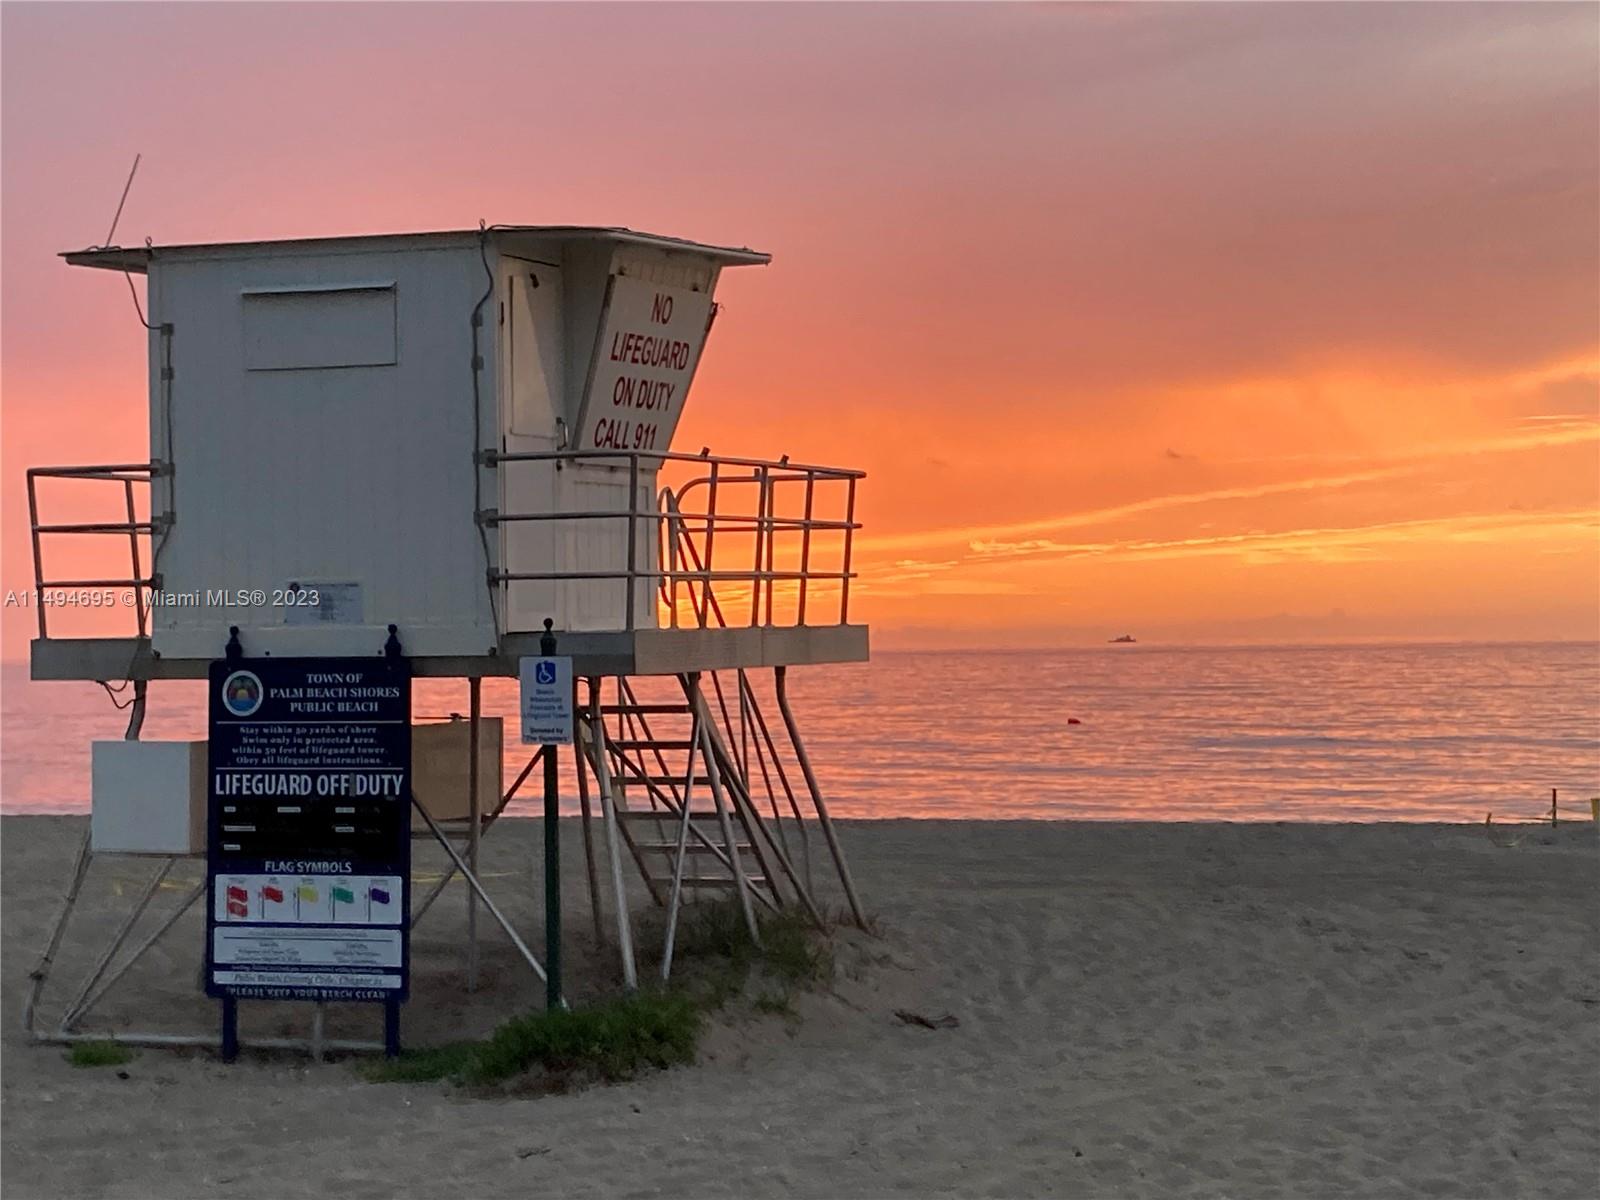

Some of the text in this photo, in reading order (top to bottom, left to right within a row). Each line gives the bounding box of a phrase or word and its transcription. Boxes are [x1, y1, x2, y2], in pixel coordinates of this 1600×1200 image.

[651, 293, 673, 325] NO
[610, 331, 690, 370] LIFEGUARD
[613, 376, 675, 411] ON DUTY
[594, 417, 657, 450] CALL 911
[306, 673, 363, 684] TOWN OF
[270, 687, 400, 698] PALM BEACH SHORES
[290, 702, 379, 712] PUBLIC BEACH
[239, 726, 259, 735] Stay
[262, 725, 292, 734] within
[309, 725, 336, 735] yards
[242, 736, 268, 744] Swim
[270, 735, 290, 745] only
[293, 735, 303, 744] in
[305, 735, 351, 745] protected
[231, 745, 263, 754] within
[279, 745, 297, 754] feet
[299, 745, 309, 754] of
[311, 745, 355, 756] lifeguard
[236, 756, 259, 766] Obey
[262, 756, 274, 764] all
[276, 756, 320, 766] lifeguard
[215, 774, 404, 796] LIFEGUARD OFF DUTY
[265, 861, 352, 873] FLAG SYMBOLS
[267, 987, 291, 997] KEEP
[294, 988, 319, 998] YOUR
[321, 989, 353, 999] BEACH
